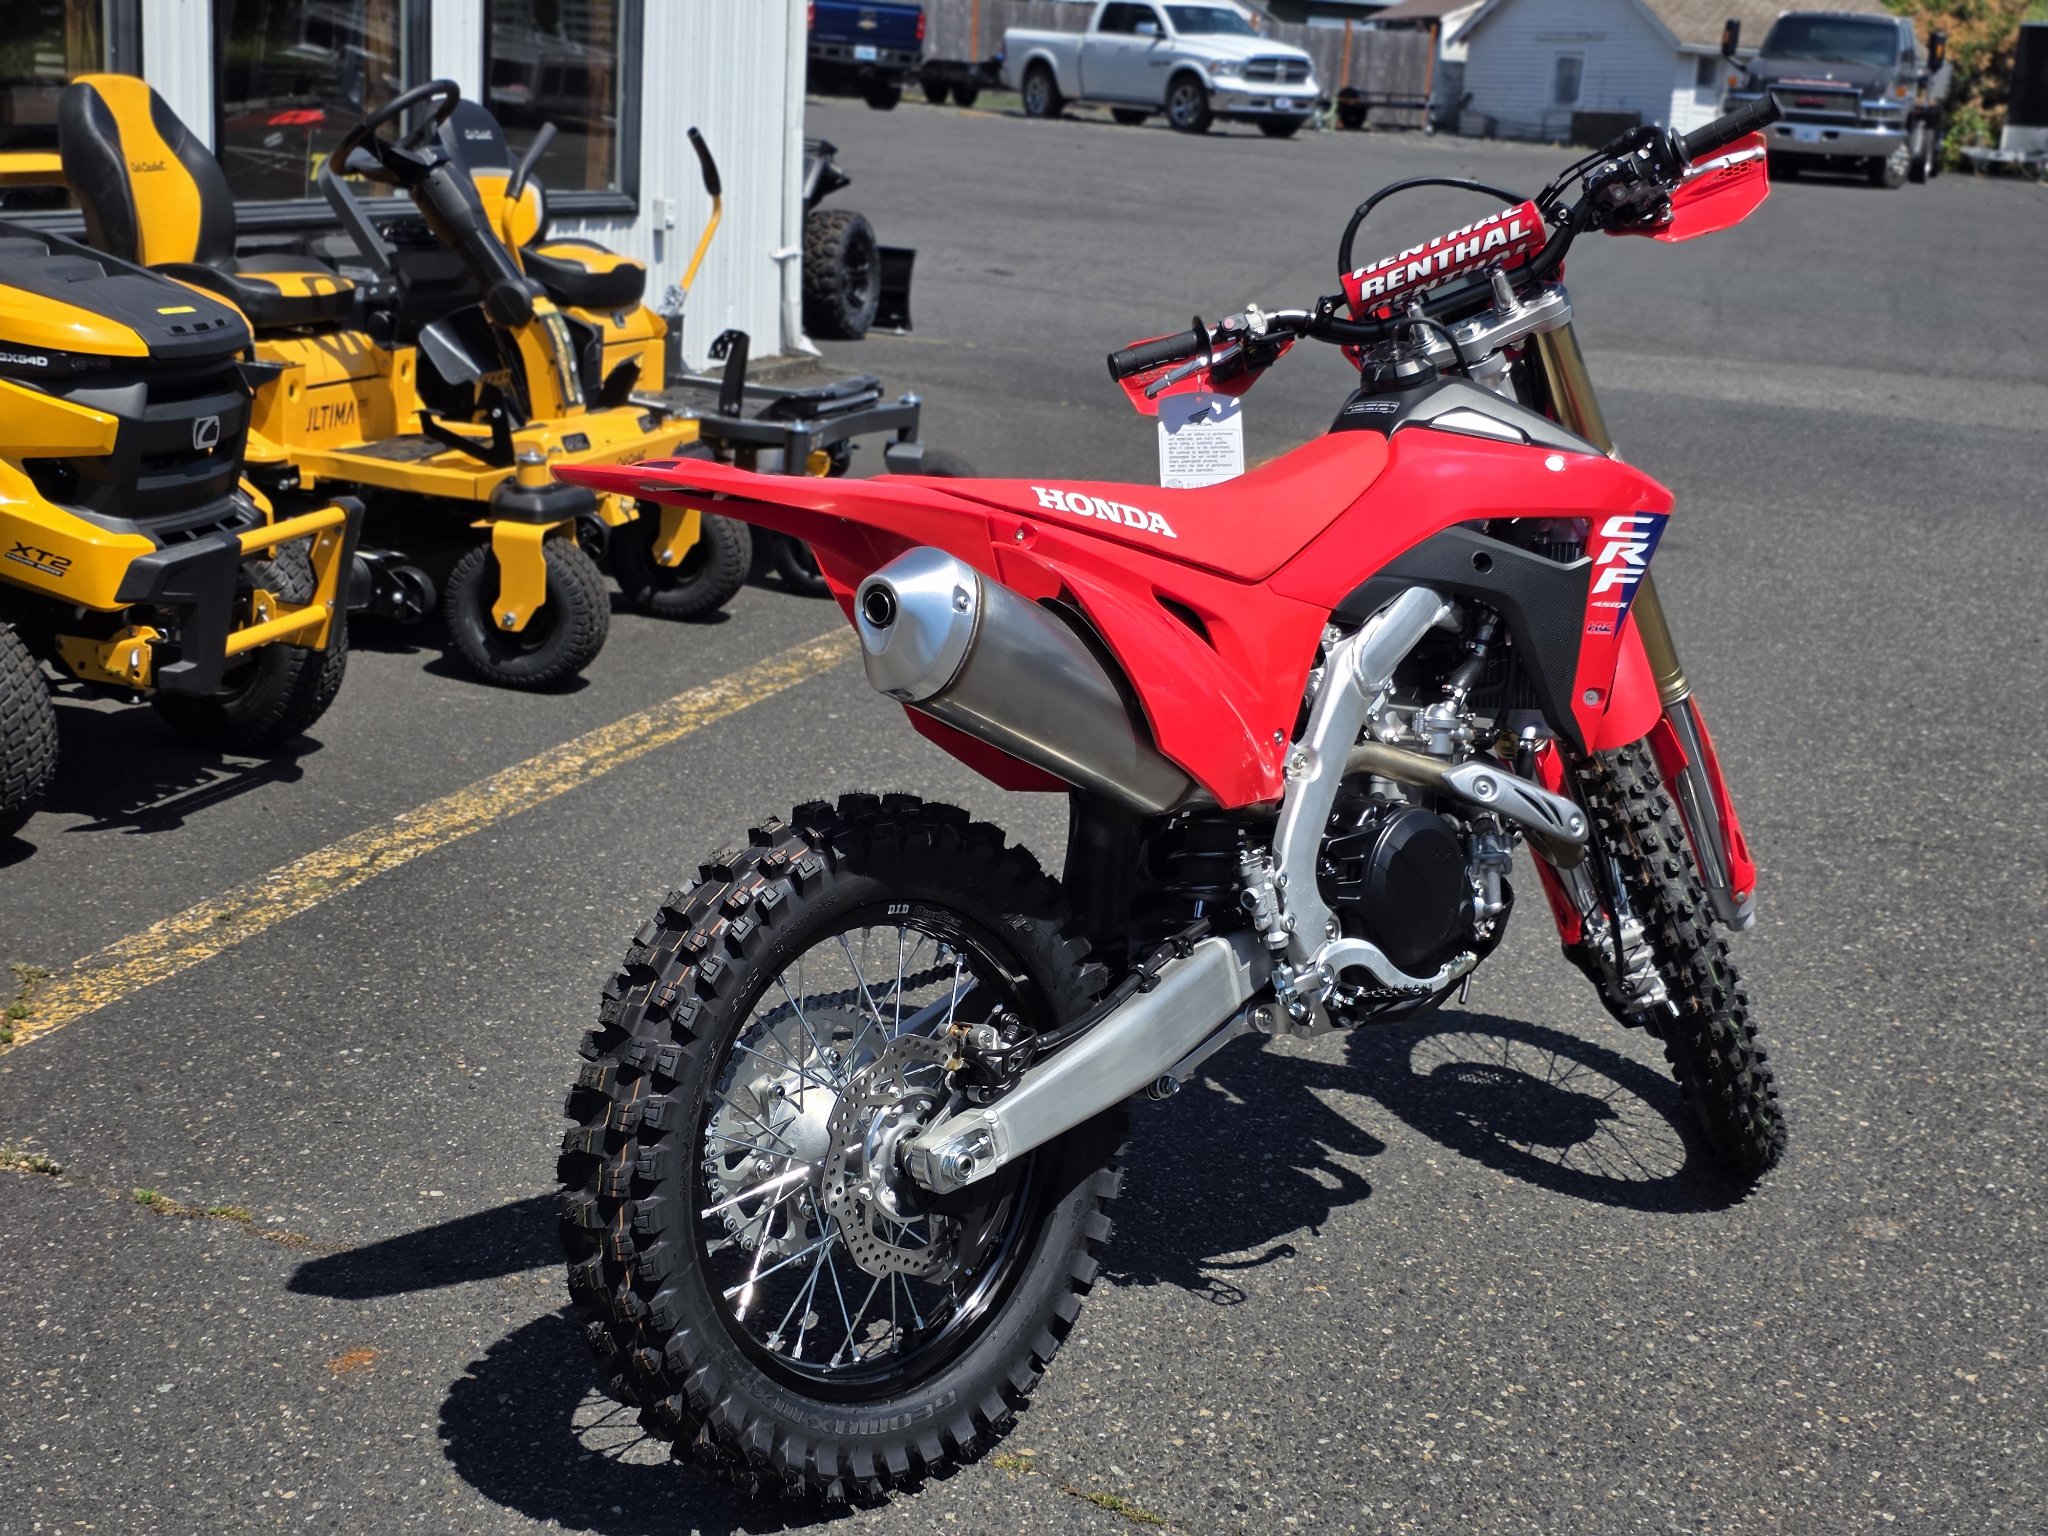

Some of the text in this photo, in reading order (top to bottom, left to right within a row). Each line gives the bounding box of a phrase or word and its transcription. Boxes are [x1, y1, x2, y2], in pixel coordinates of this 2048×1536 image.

[1361, 219, 1532, 301] RENTHAL
[1030, 486, 1178, 539] HONDA
[9, 540, 73, 572] XT2
[1591, 515, 1654, 595] CRF
[1591, 601, 1628, 609] 450X
